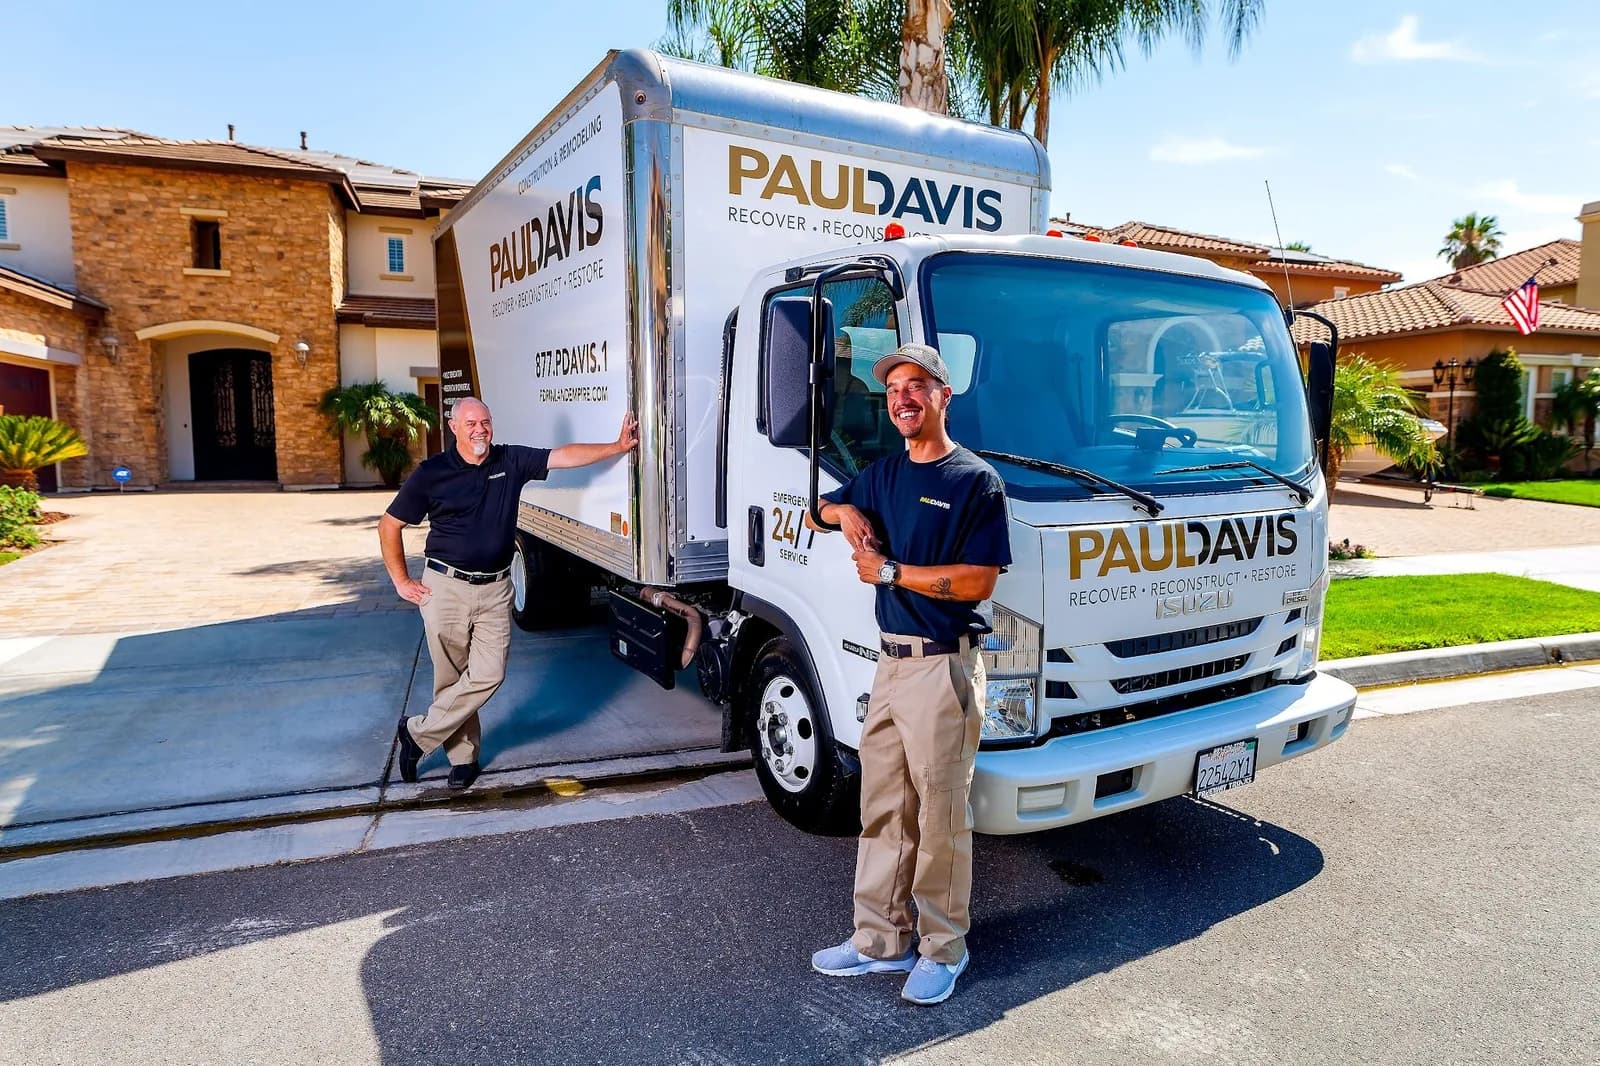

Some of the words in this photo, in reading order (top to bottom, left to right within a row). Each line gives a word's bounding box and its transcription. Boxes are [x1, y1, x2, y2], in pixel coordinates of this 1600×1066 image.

[559, 114, 602, 163] REMODELING
[728, 206, 806, 232] RECOVER
[518, 276, 562, 309] RECONSTRUCT
[568, 258, 604, 290] RESTORE
[773, 492, 811, 508] EMERGEN
[780, 548, 808, 566] SERVICE
[1069, 585, 1137, 607] RECOVER
[1151, 571, 1241, 595] RECONSTRUCT
[1251, 563, 1297, 583] RESTORE
[1155, 588, 1234, 620] ISUZU
[1199, 756, 1250, 790] 22542Y1
